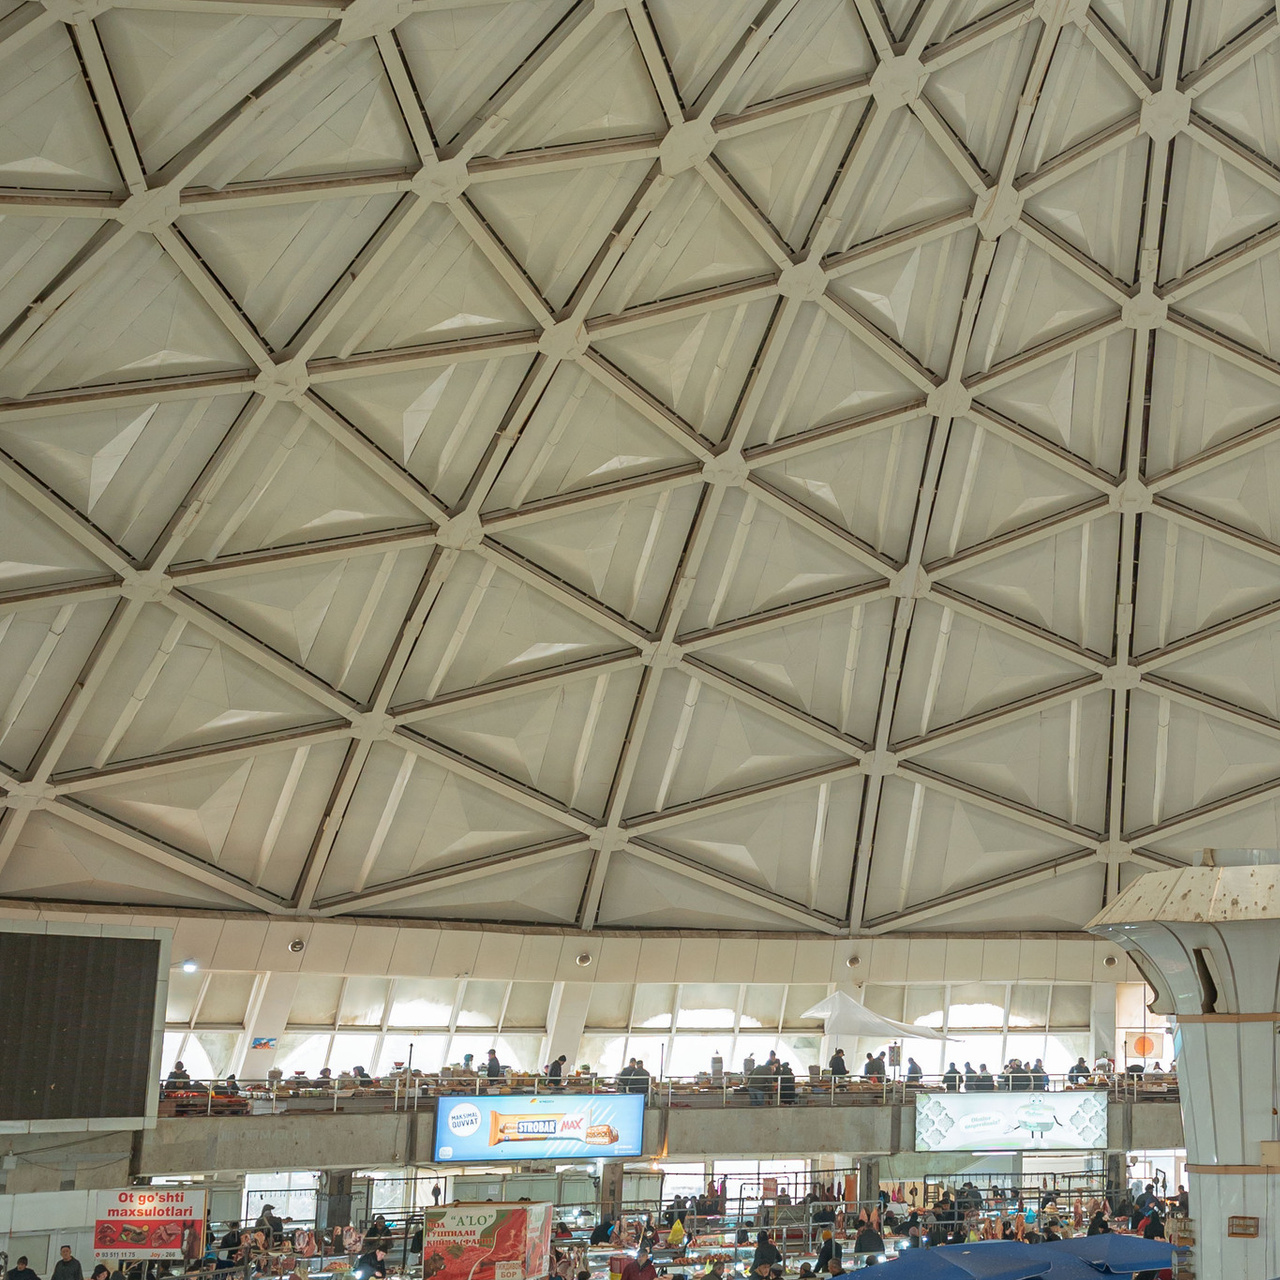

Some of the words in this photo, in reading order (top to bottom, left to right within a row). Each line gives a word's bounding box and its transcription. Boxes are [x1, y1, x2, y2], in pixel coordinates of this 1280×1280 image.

[451, 1112, 478, 1121] MAKSIMAL
[452, 1118, 478, 1129] QUVVAT
[518, 1121, 555, 1134] STROBAR
[560, 1118, 583, 1132] MAX
[118, 1192, 134, 1203] Ot
[138, 1192, 184, 1205] go'shti
[107, 1206, 193, 1217] maxsulotlari
